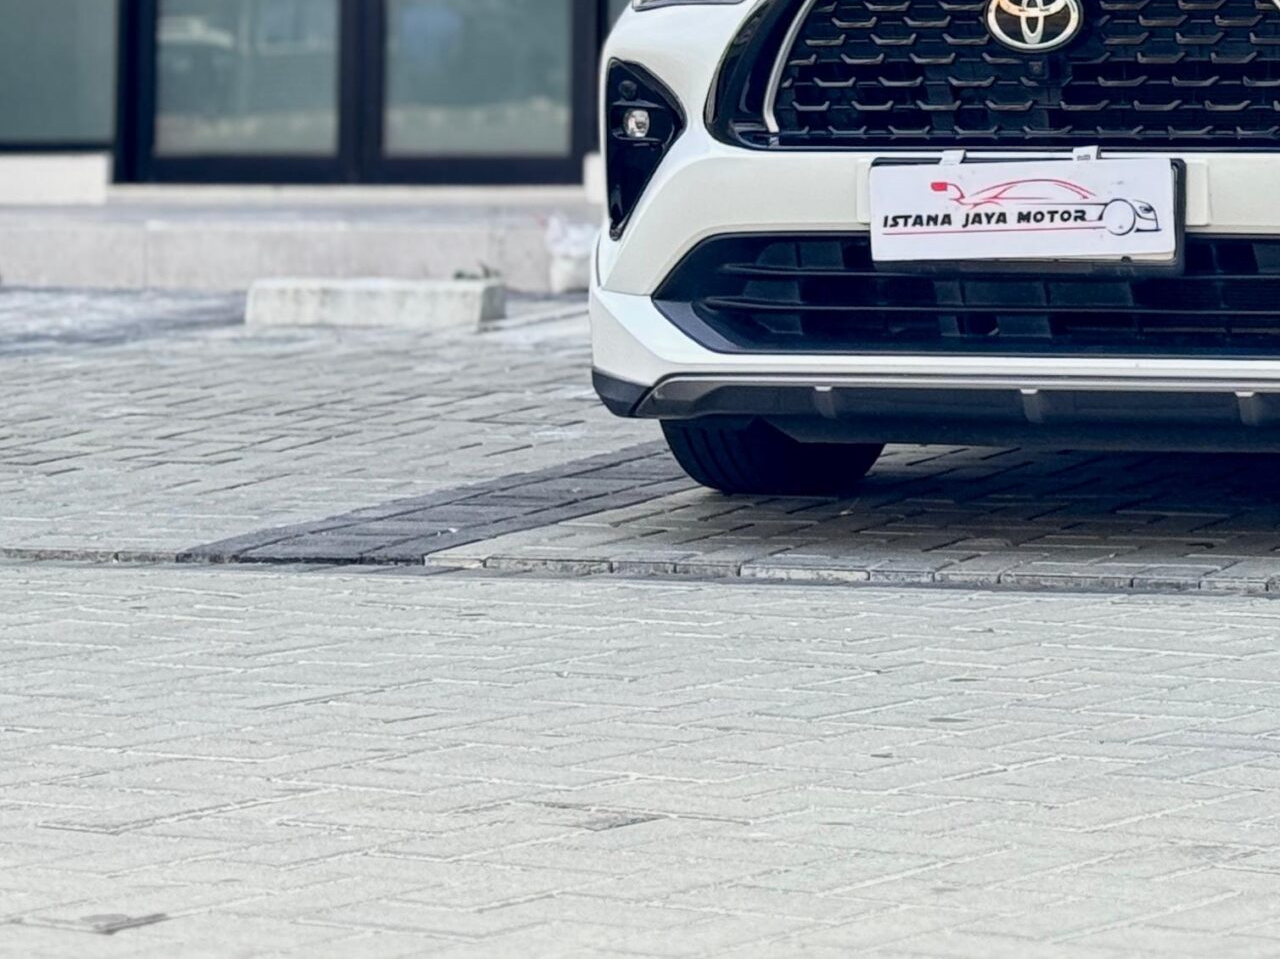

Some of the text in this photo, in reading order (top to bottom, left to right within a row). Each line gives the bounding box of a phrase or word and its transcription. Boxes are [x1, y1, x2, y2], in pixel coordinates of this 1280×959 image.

[882, 209, 1087, 229] ISTANA JAYA MOTOR
